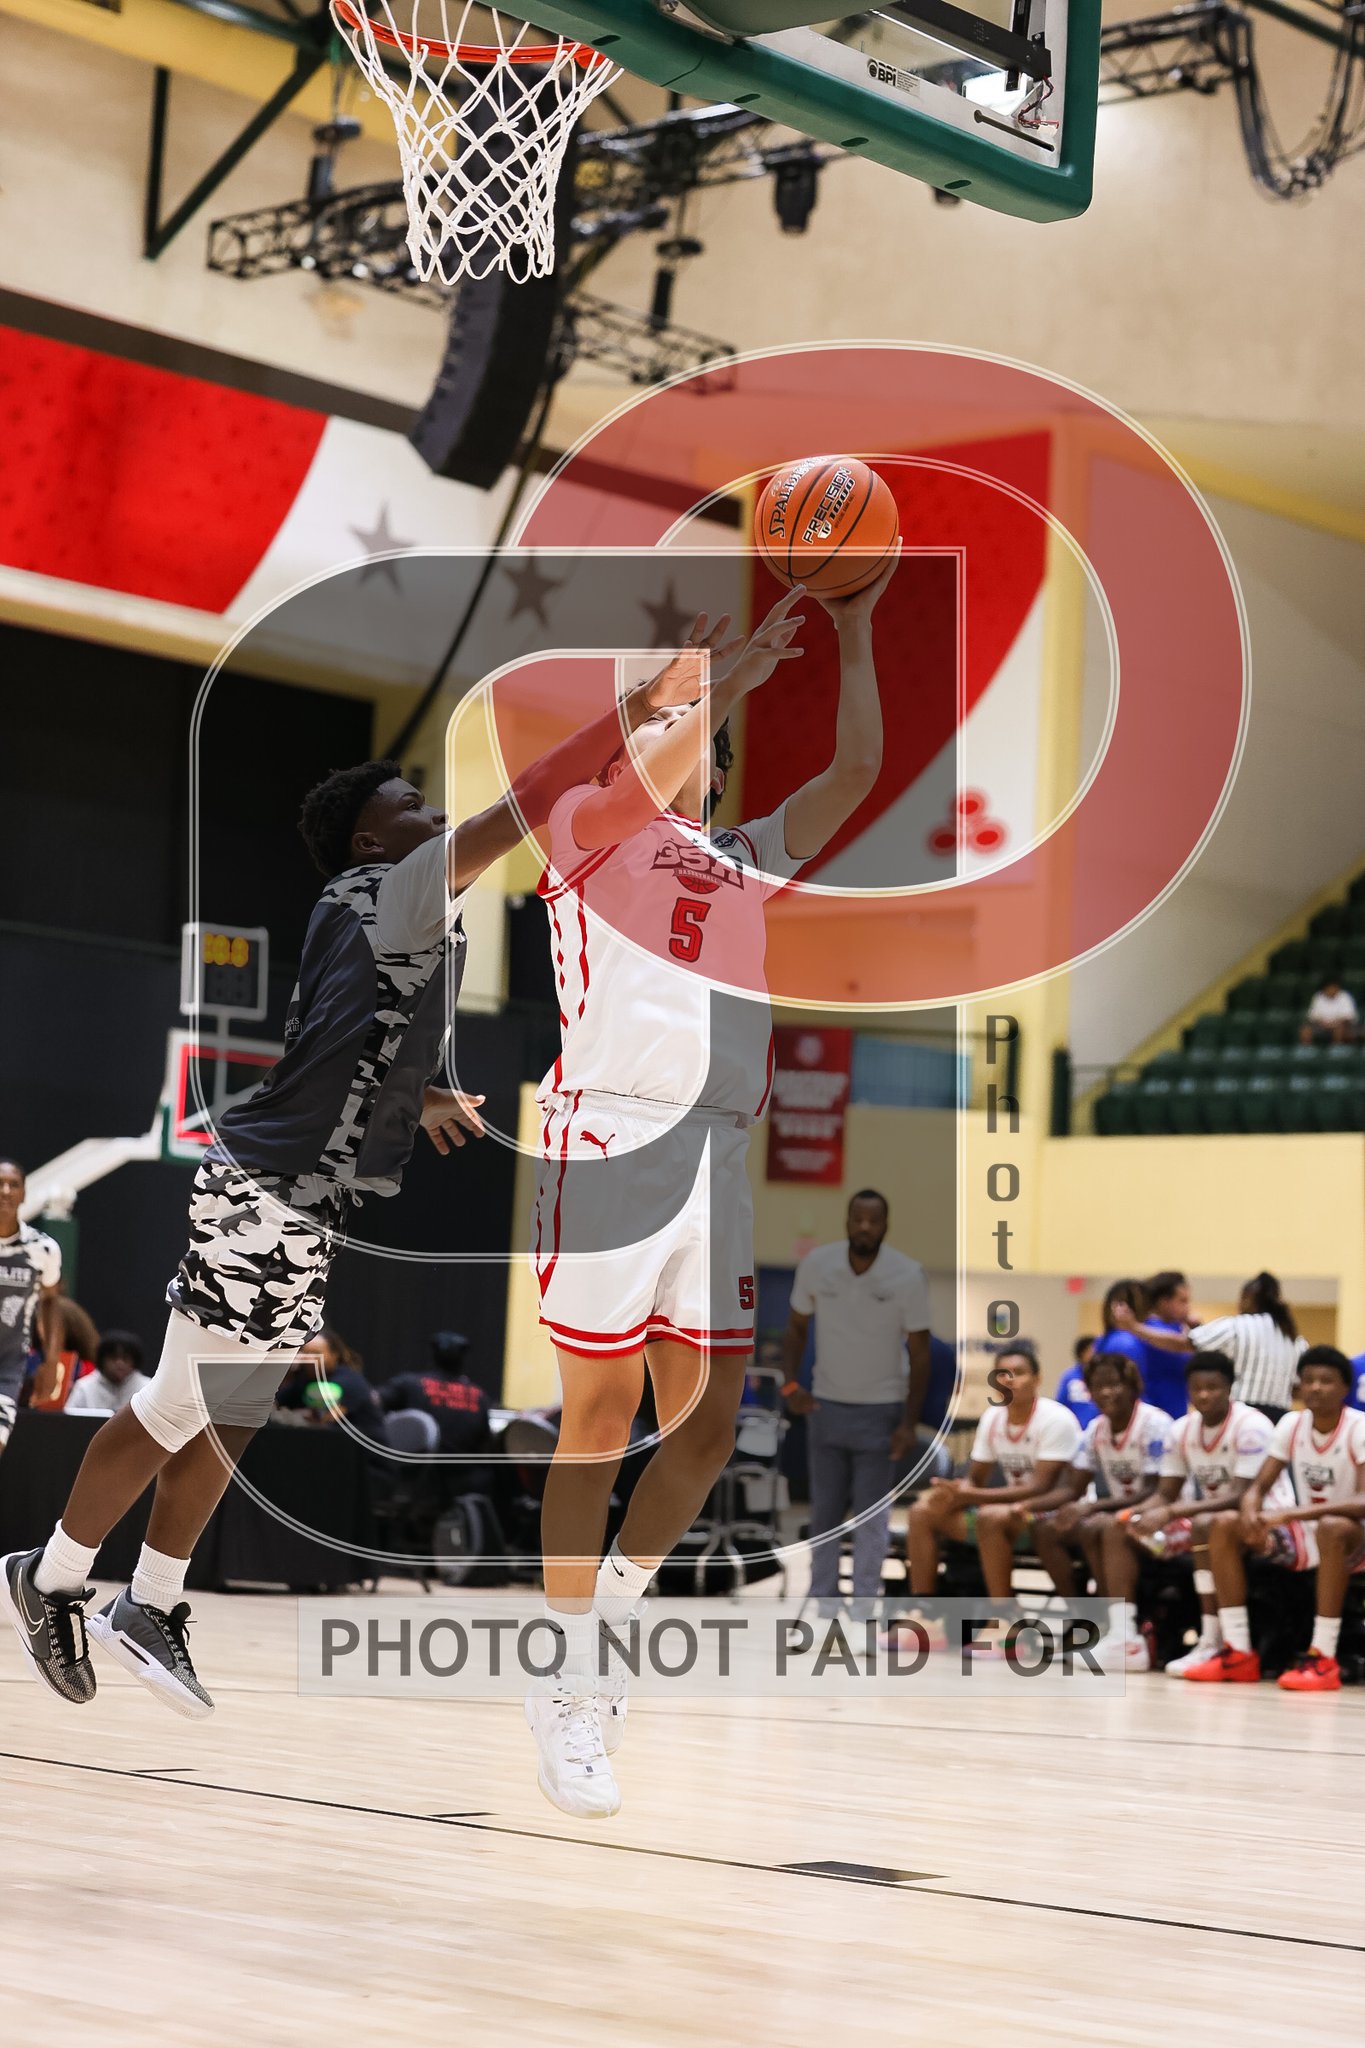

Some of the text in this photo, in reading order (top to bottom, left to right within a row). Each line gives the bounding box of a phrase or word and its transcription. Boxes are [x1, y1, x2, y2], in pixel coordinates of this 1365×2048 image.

[877, 67, 897, 87] BPI
[768, 457, 824, 538] SPALDI
[801, 466, 852, 544] PRECISION
[829, 477, 856, 520] 1000
[668, 896, 712, 963] 5
[738, 1275, 755, 1311] 5
